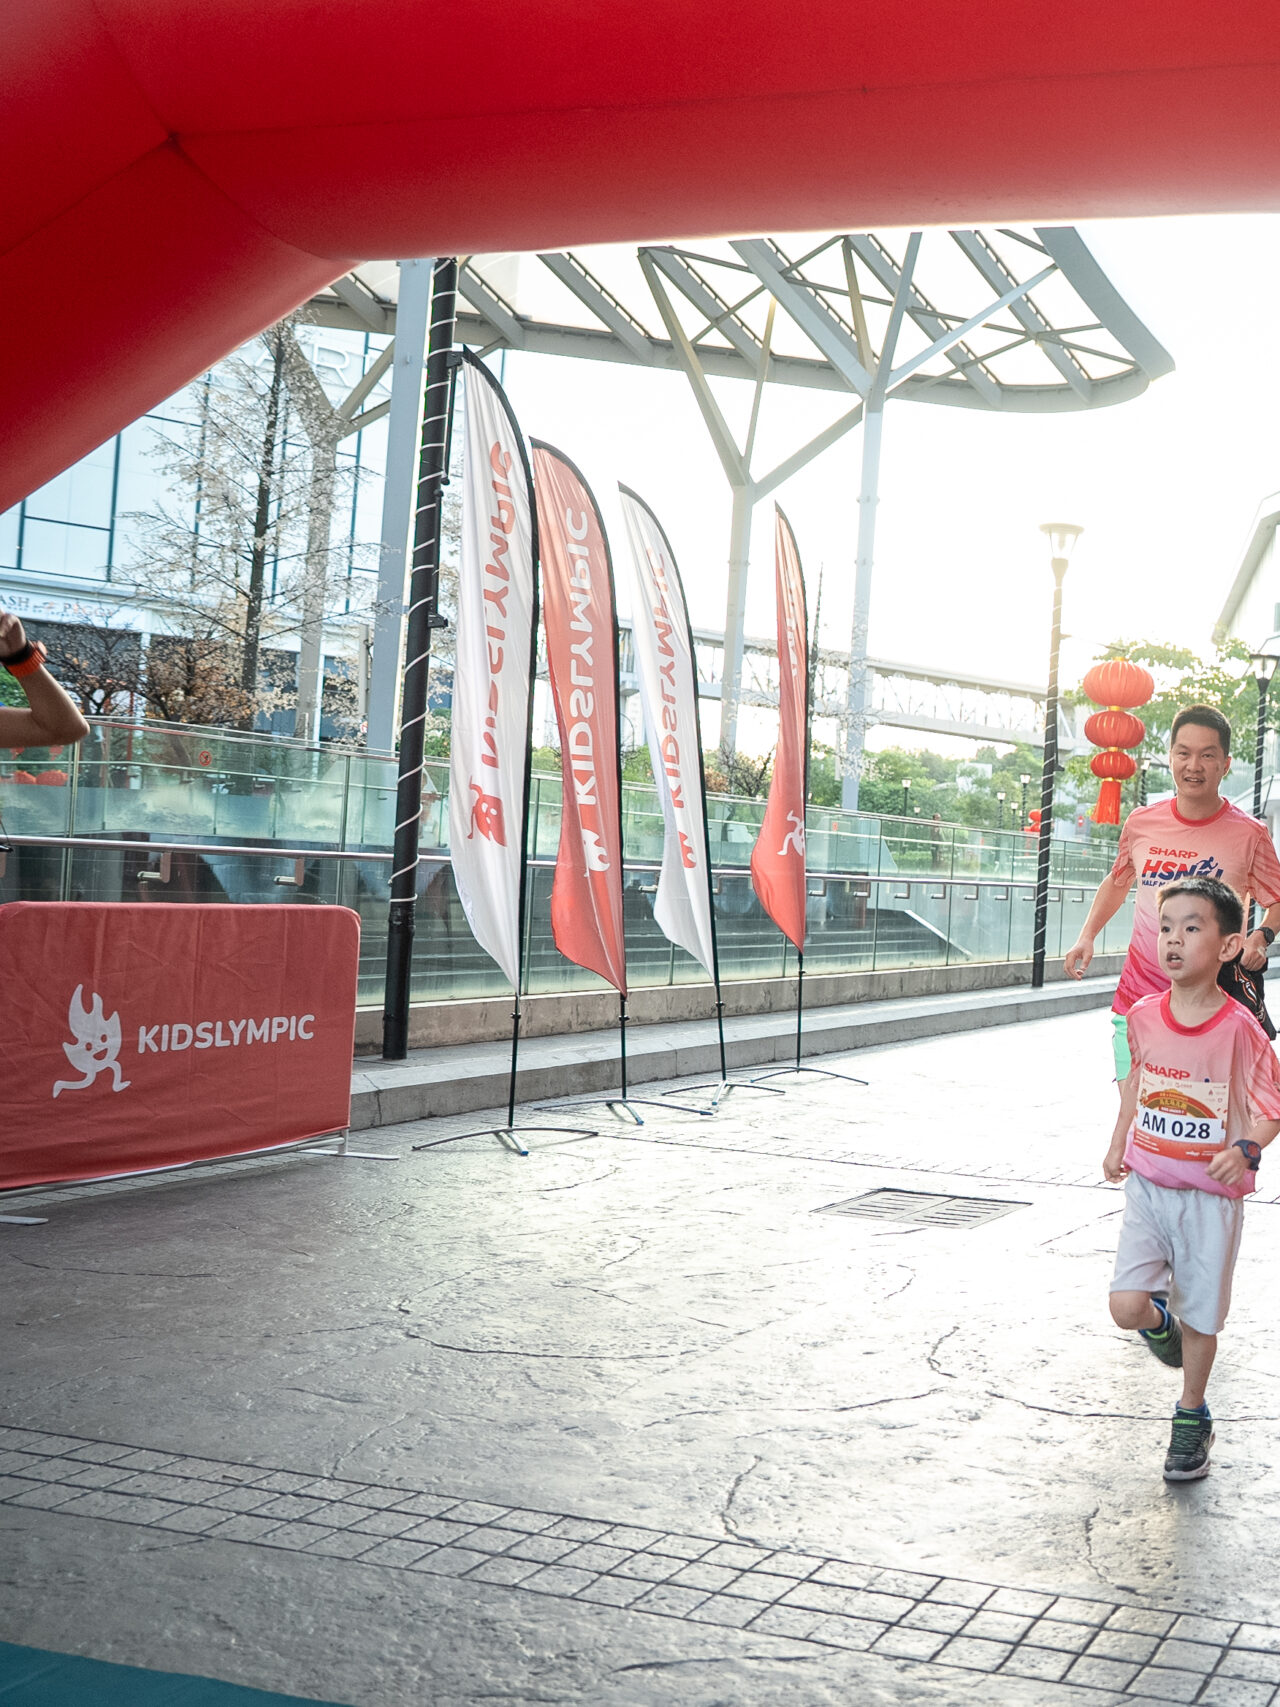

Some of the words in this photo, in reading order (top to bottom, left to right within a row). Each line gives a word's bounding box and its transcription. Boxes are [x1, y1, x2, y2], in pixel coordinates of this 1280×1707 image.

[1149, 846, 1199, 860] SHARP
[138, 1014, 315, 1054] KIDSLYMPIC
[1144, 1062, 1191, 1080] SHARP
[1142, 1112, 1166, 1135] AM
[1171, 1120, 1211, 1140] 028
